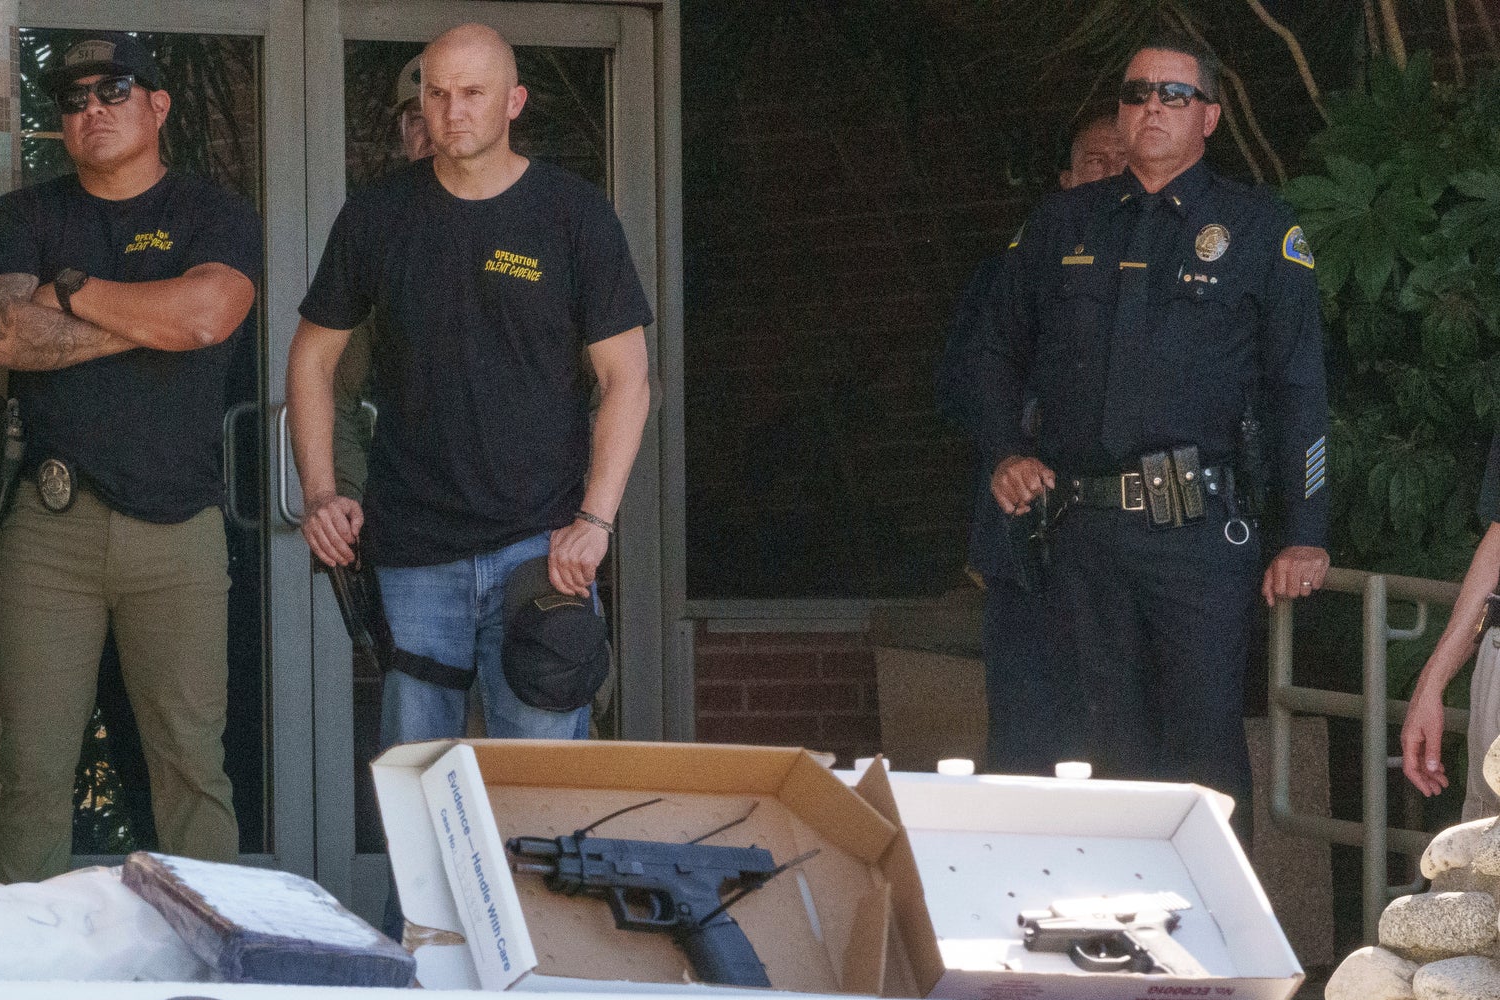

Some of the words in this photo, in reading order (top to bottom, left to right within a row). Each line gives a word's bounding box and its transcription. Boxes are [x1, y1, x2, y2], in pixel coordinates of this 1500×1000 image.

[485, 260, 511, 274] SILENT
[509, 265, 543, 282] CADENCE
[494, 249, 539, 269] OPERATION
[440, 808, 451, 834] Case
[447, 770, 470, 836] Evidence
[471, 852, 490, 904] Handle
[487, 903, 501, 938] With
[497, 937, 511, 973] Care
